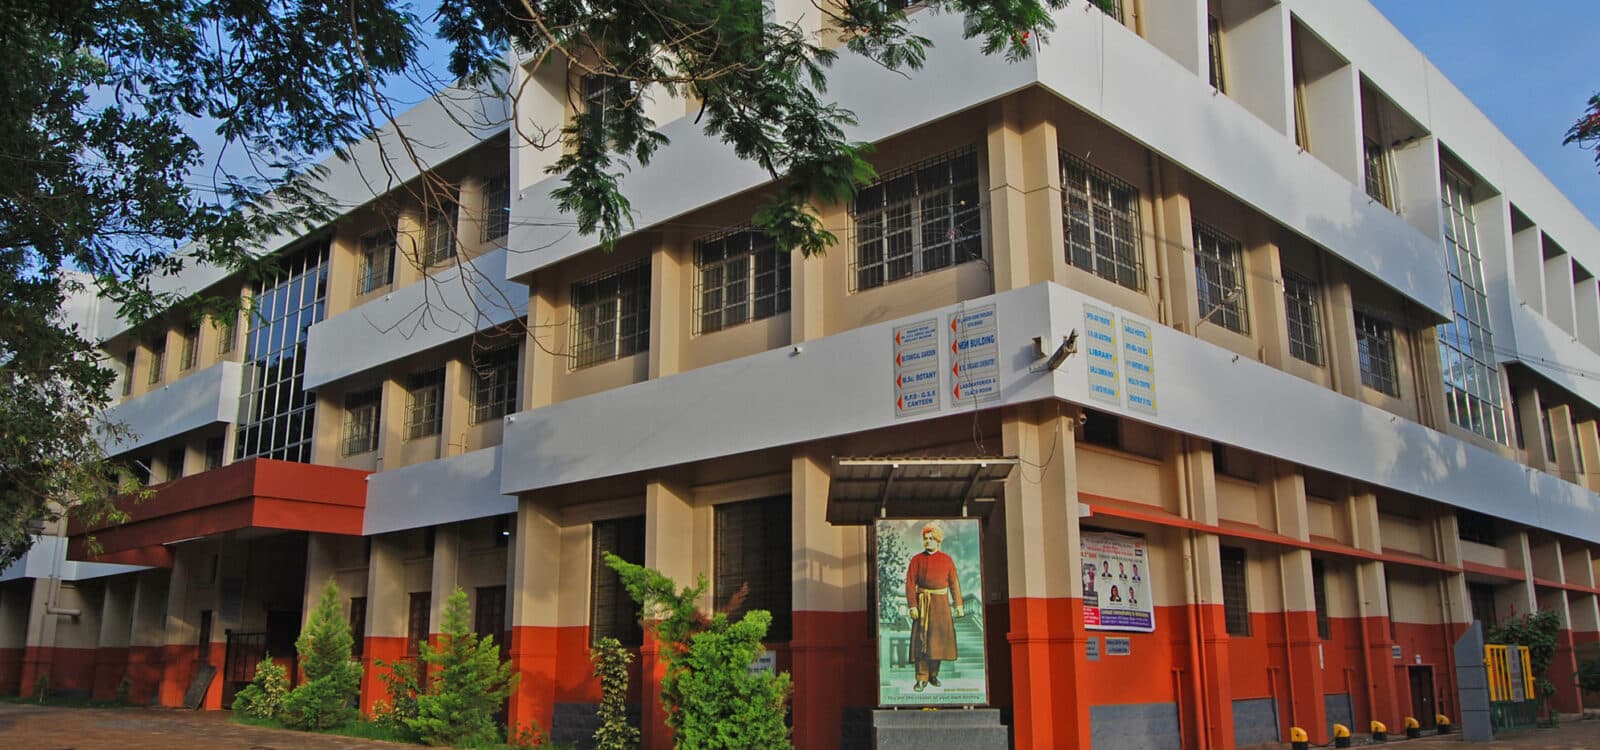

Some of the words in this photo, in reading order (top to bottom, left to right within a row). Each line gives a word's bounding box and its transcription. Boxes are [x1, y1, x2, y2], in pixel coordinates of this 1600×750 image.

[970, 335, 995, 348] BUILDING
[1088, 348, 1113, 360] LIBRARY
[916, 371, 936, 382] BOTANY
[907, 398, 933, 408] CANTEEN
